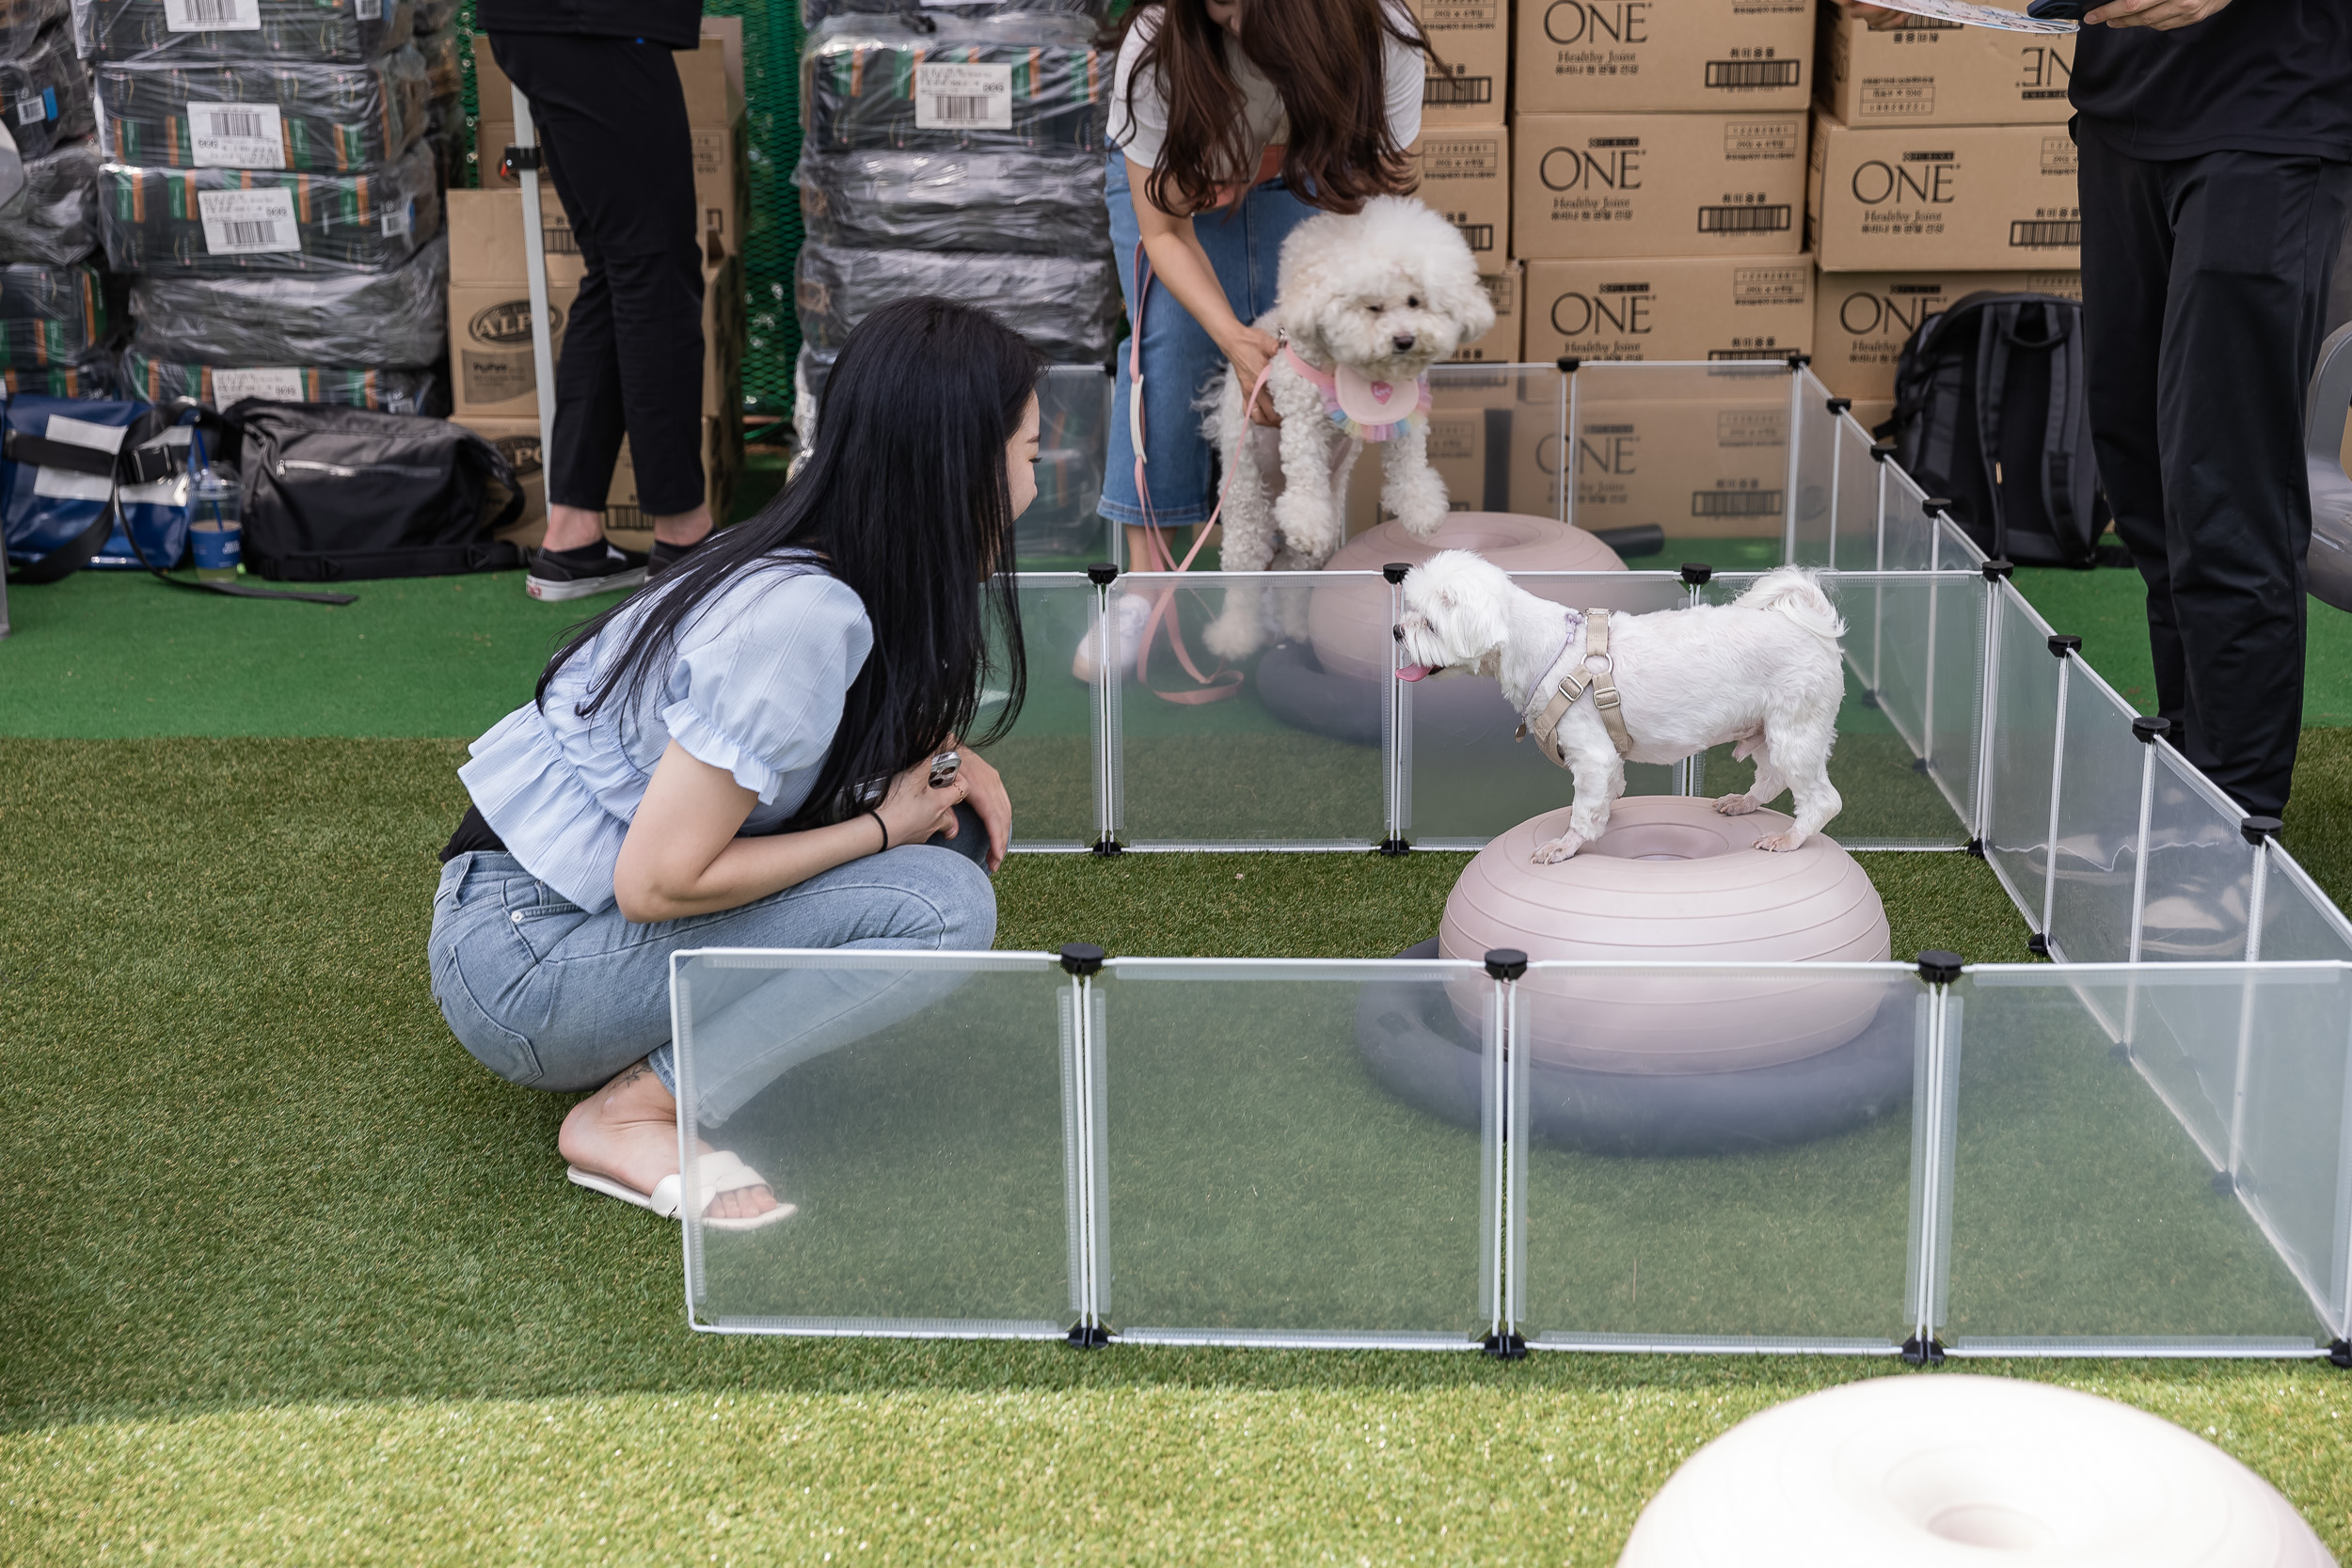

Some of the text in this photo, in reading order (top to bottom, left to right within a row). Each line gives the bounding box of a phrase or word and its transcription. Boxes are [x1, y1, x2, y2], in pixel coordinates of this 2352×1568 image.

[1544, 0, 1648, 44] ONE
[1557, 50, 1636, 63] Healthy Joint
[2021, 46, 2073, 87] NE
[1539, 146, 1642, 192] ONE
[1851, 160, 1956, 205] ONE
[1552, 196, 1630, 210] Healthy Joint
[1864, 210, 1942, 224] Healthy Joint
[1550, 292, 1652, 336] ONE
[1565, 341, 1641, 353] Healthy Joint
[1851, 340, 1898, 353] Healthy
[1535, 433, 1635, 476] ONE
